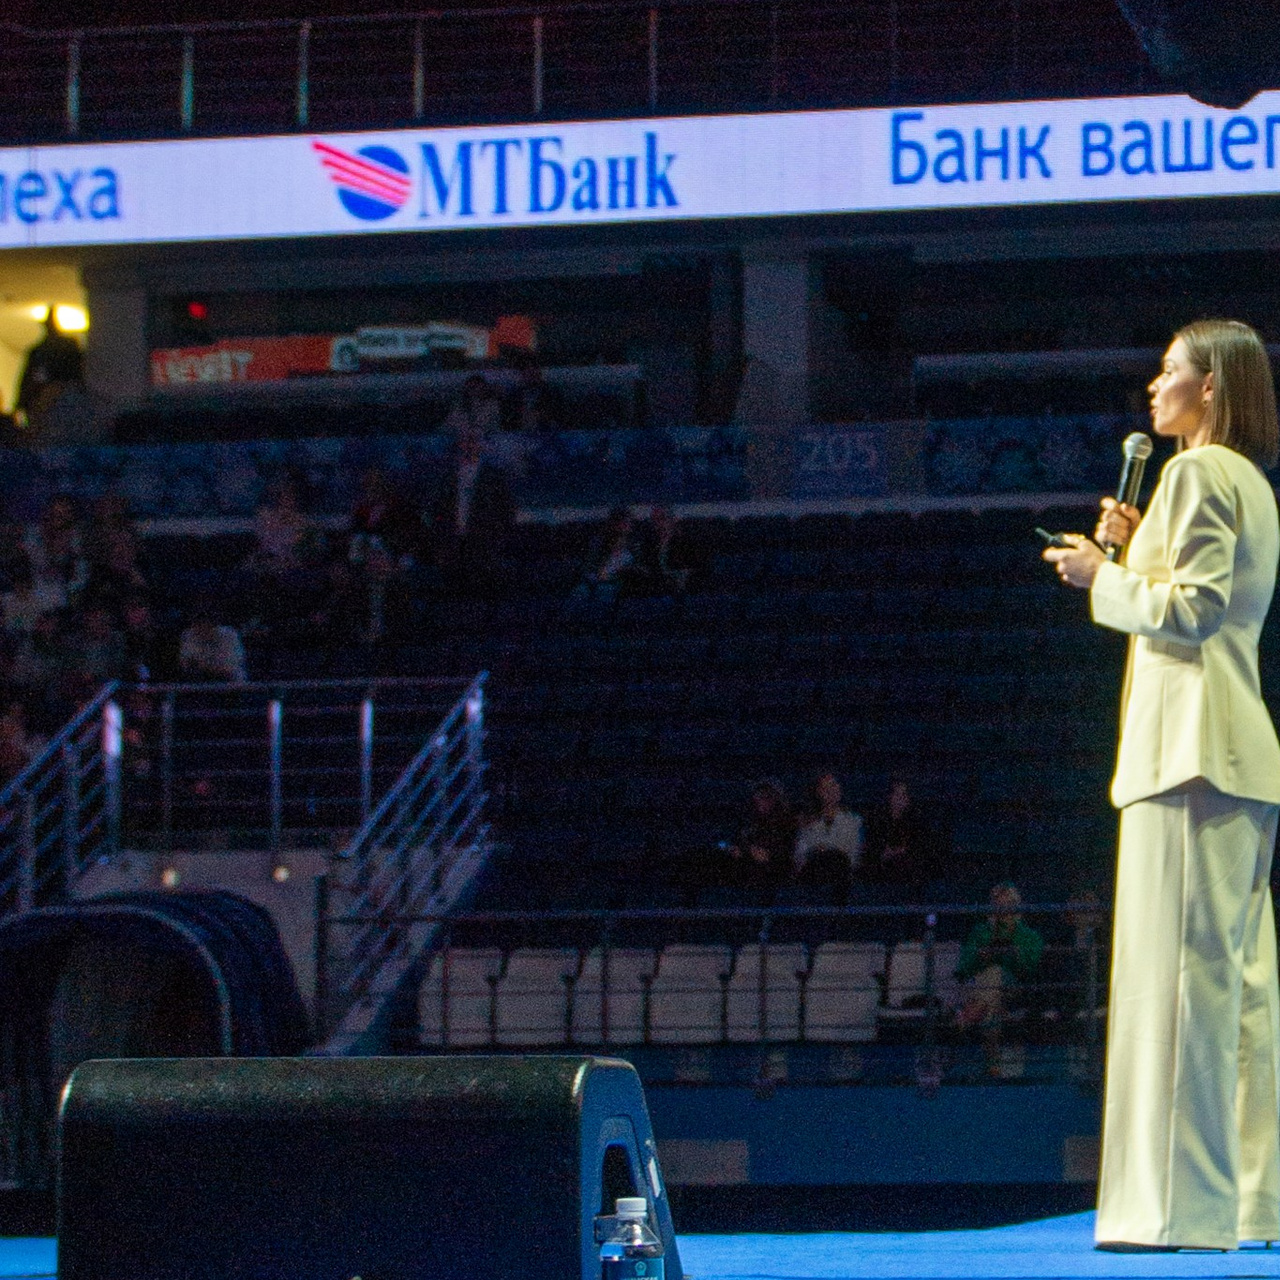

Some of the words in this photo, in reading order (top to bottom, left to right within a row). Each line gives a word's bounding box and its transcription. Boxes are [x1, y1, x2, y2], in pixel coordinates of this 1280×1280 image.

[419, 131, 678, 218] МТБанк
[892, 111, 1051, 185] Банк
[0, 167, 121, 223] еха
